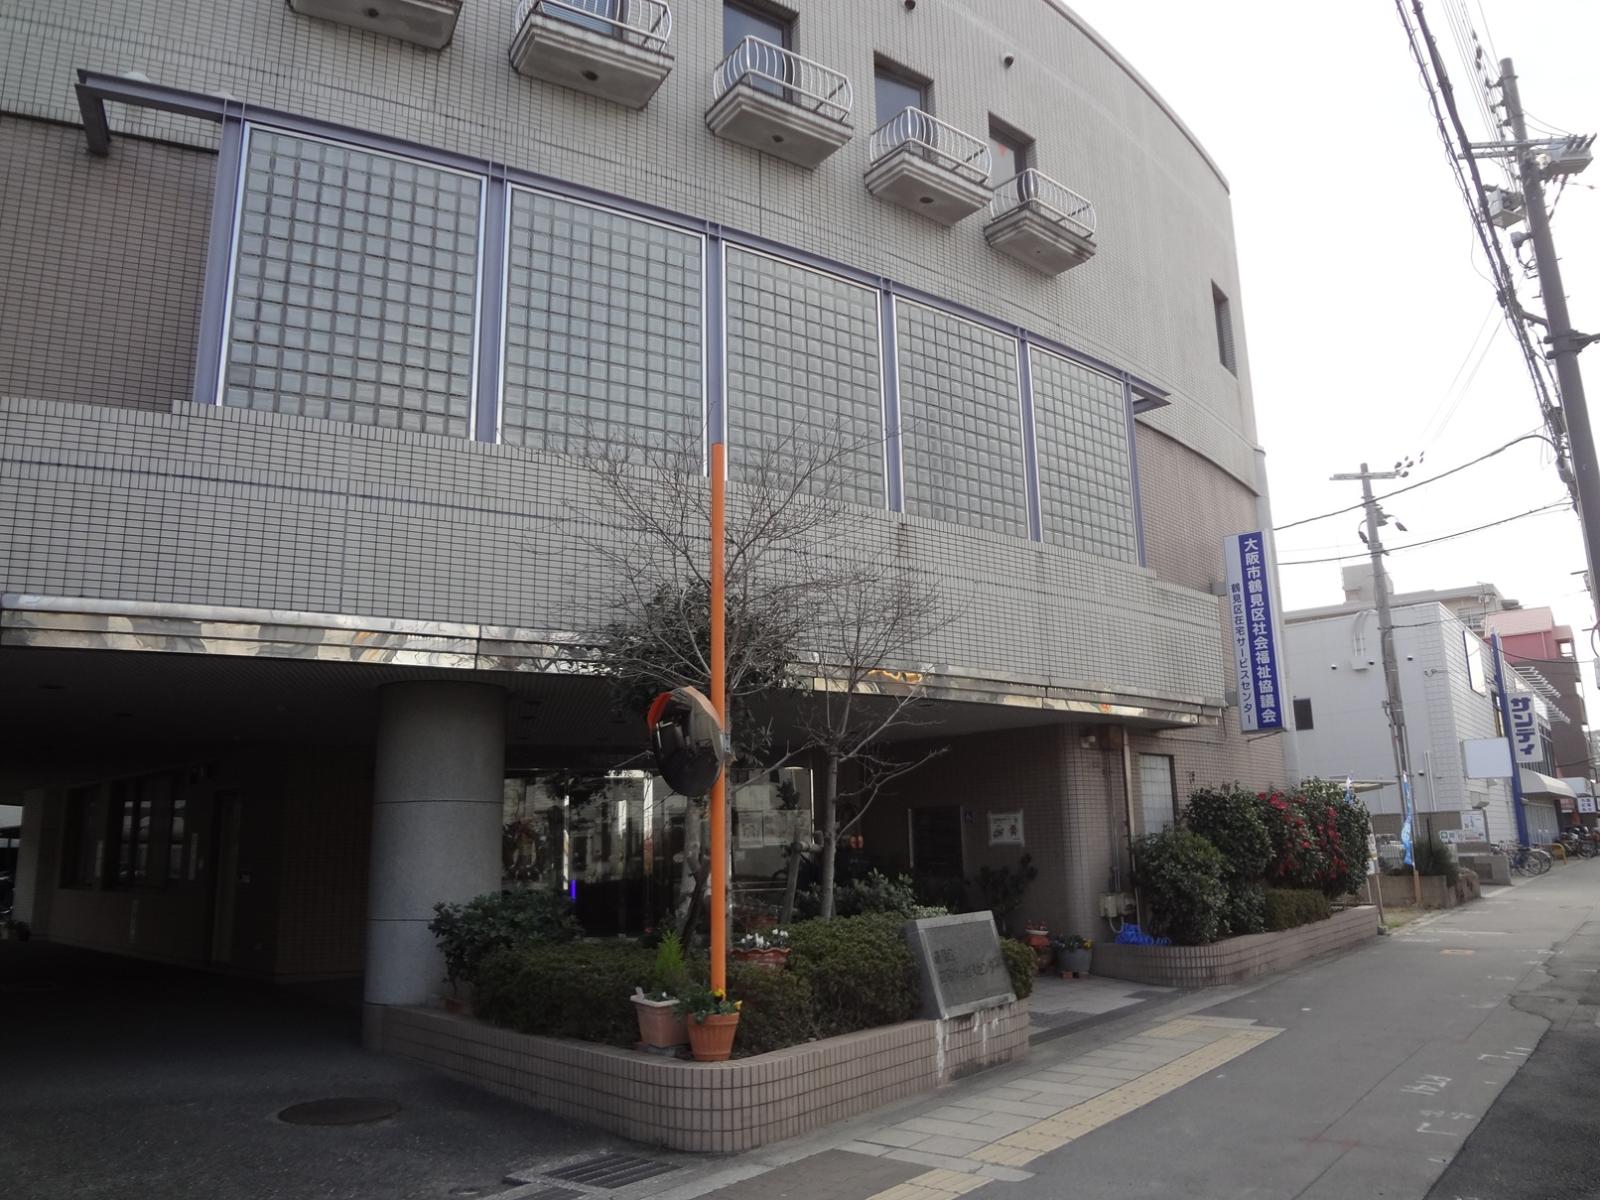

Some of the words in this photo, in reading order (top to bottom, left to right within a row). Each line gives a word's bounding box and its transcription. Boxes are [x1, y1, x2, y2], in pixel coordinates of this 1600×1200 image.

[1231, 583, 1252, 724] 鶴見区在宅サービスセンター
[1244, 538, 1277, 724] 大阪市鶴見区社会福祉協議会
